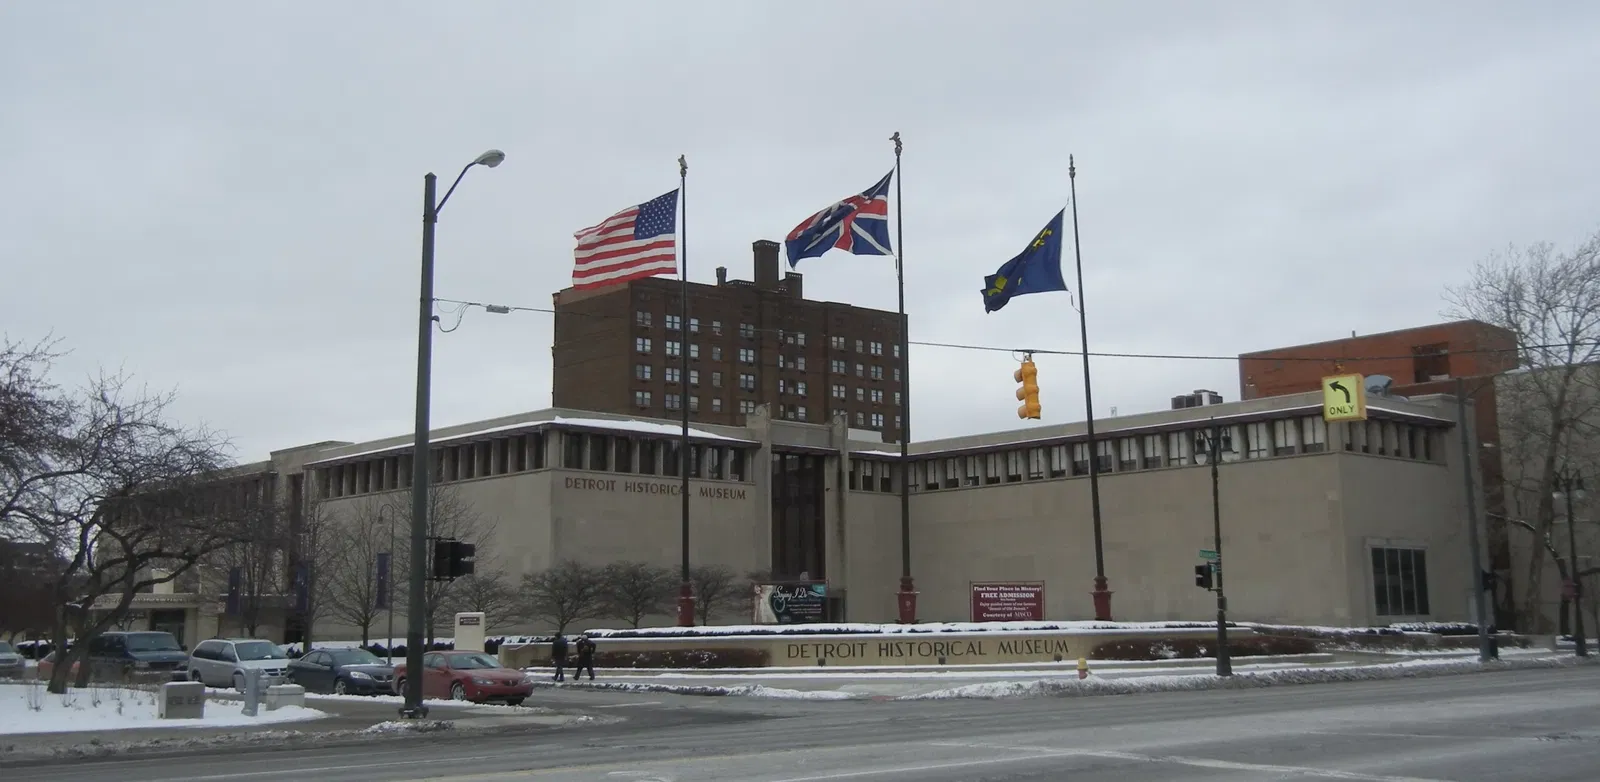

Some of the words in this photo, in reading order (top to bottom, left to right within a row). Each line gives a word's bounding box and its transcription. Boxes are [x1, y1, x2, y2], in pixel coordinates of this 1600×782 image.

[1329, 405, 1354, 415] ONLY
[565, 477, 616, 492] DETROIT
[624, 481, 692, 497] HISTORICA
[700, 486, 746, 500] MUSEUM
[773, 585, 793, 602] Saying
[787, 643, 867, 659] DETROIT
[878, 640, 987, 658] HISTORICAL
[997, 639, 1069, 655] MUSEUM
